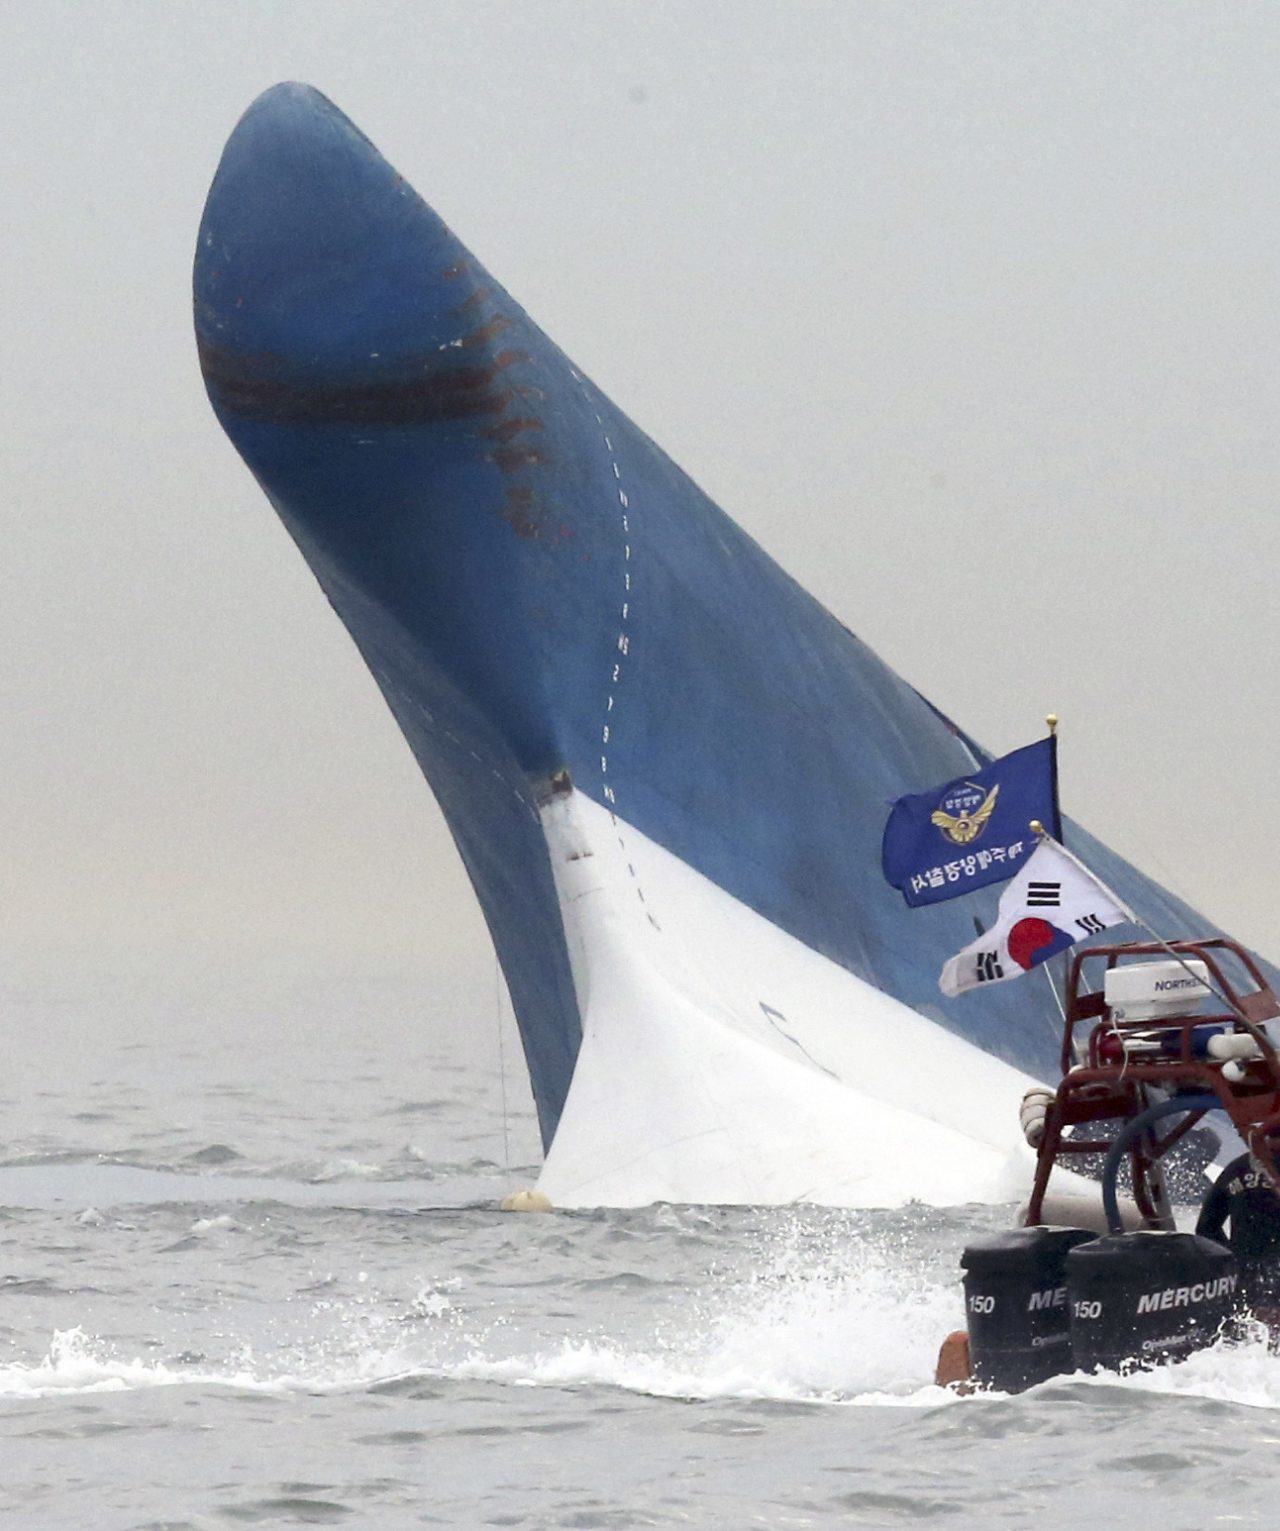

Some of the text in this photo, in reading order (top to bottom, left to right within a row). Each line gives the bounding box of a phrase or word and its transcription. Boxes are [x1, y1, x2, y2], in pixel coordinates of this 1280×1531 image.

[1155, 977, 1203, 991] NORTHS
[1027, 1286, 1068, 1312] ME
[1136, 1273, 1238, 1315] MERCURY
[968, 1295, 996, 1314] 150
[1073, 1301, 1103, 1319] 150
